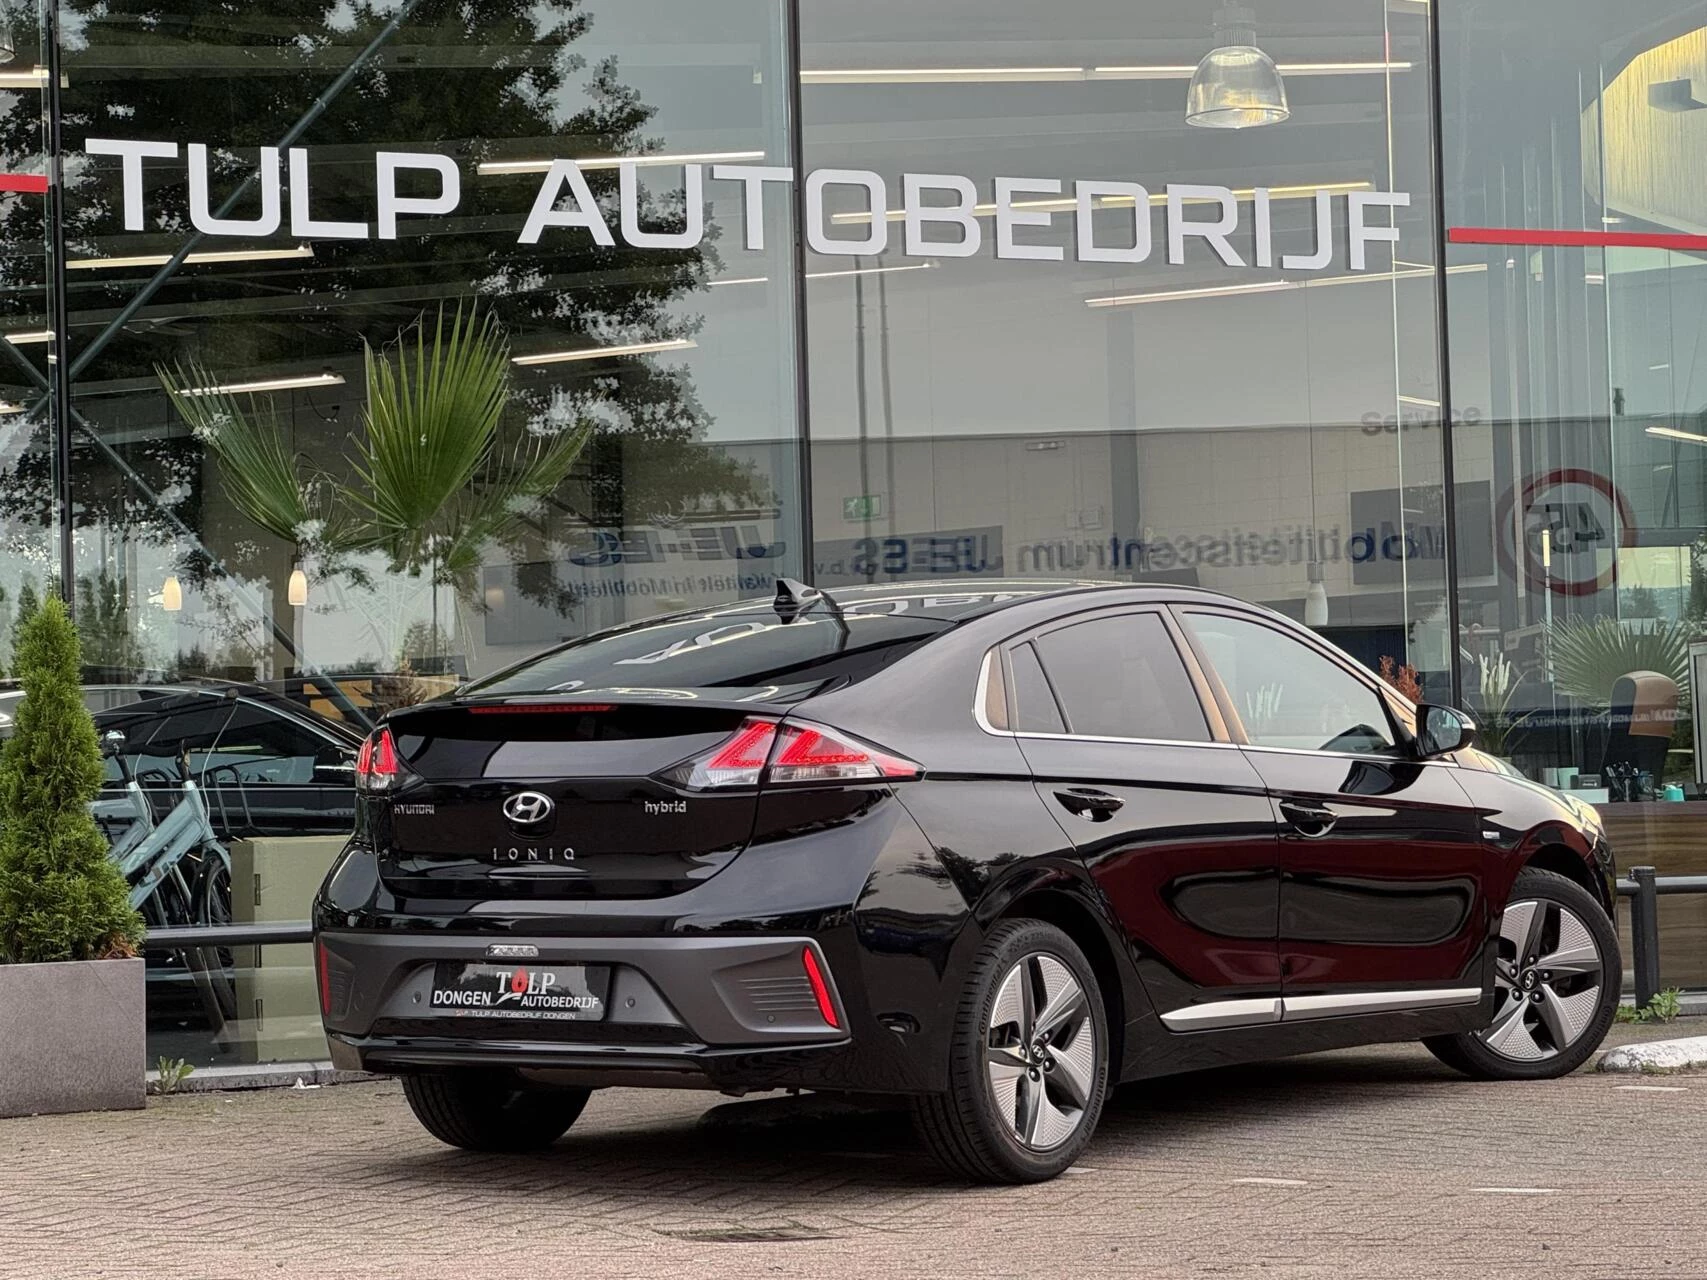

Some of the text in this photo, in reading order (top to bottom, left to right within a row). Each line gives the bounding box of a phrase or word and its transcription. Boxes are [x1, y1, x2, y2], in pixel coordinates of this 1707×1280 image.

[85, 138, 1411, 271] TULP AUTOBEDRIJF
[394, 803, 435, 815] HYUNDAI
[644, 800, 687, 813] hybrid
[493, 847, 575, 861] IONIQ
[433, 990, 600, 1009] DONGEN AUTOBEDRIJF
[471, 1009, 490, 1018] TULP
[491, 1010, 541, 1019] AUTOBEDRIJF
[542, 1011, 576, 1020] DONGEN
